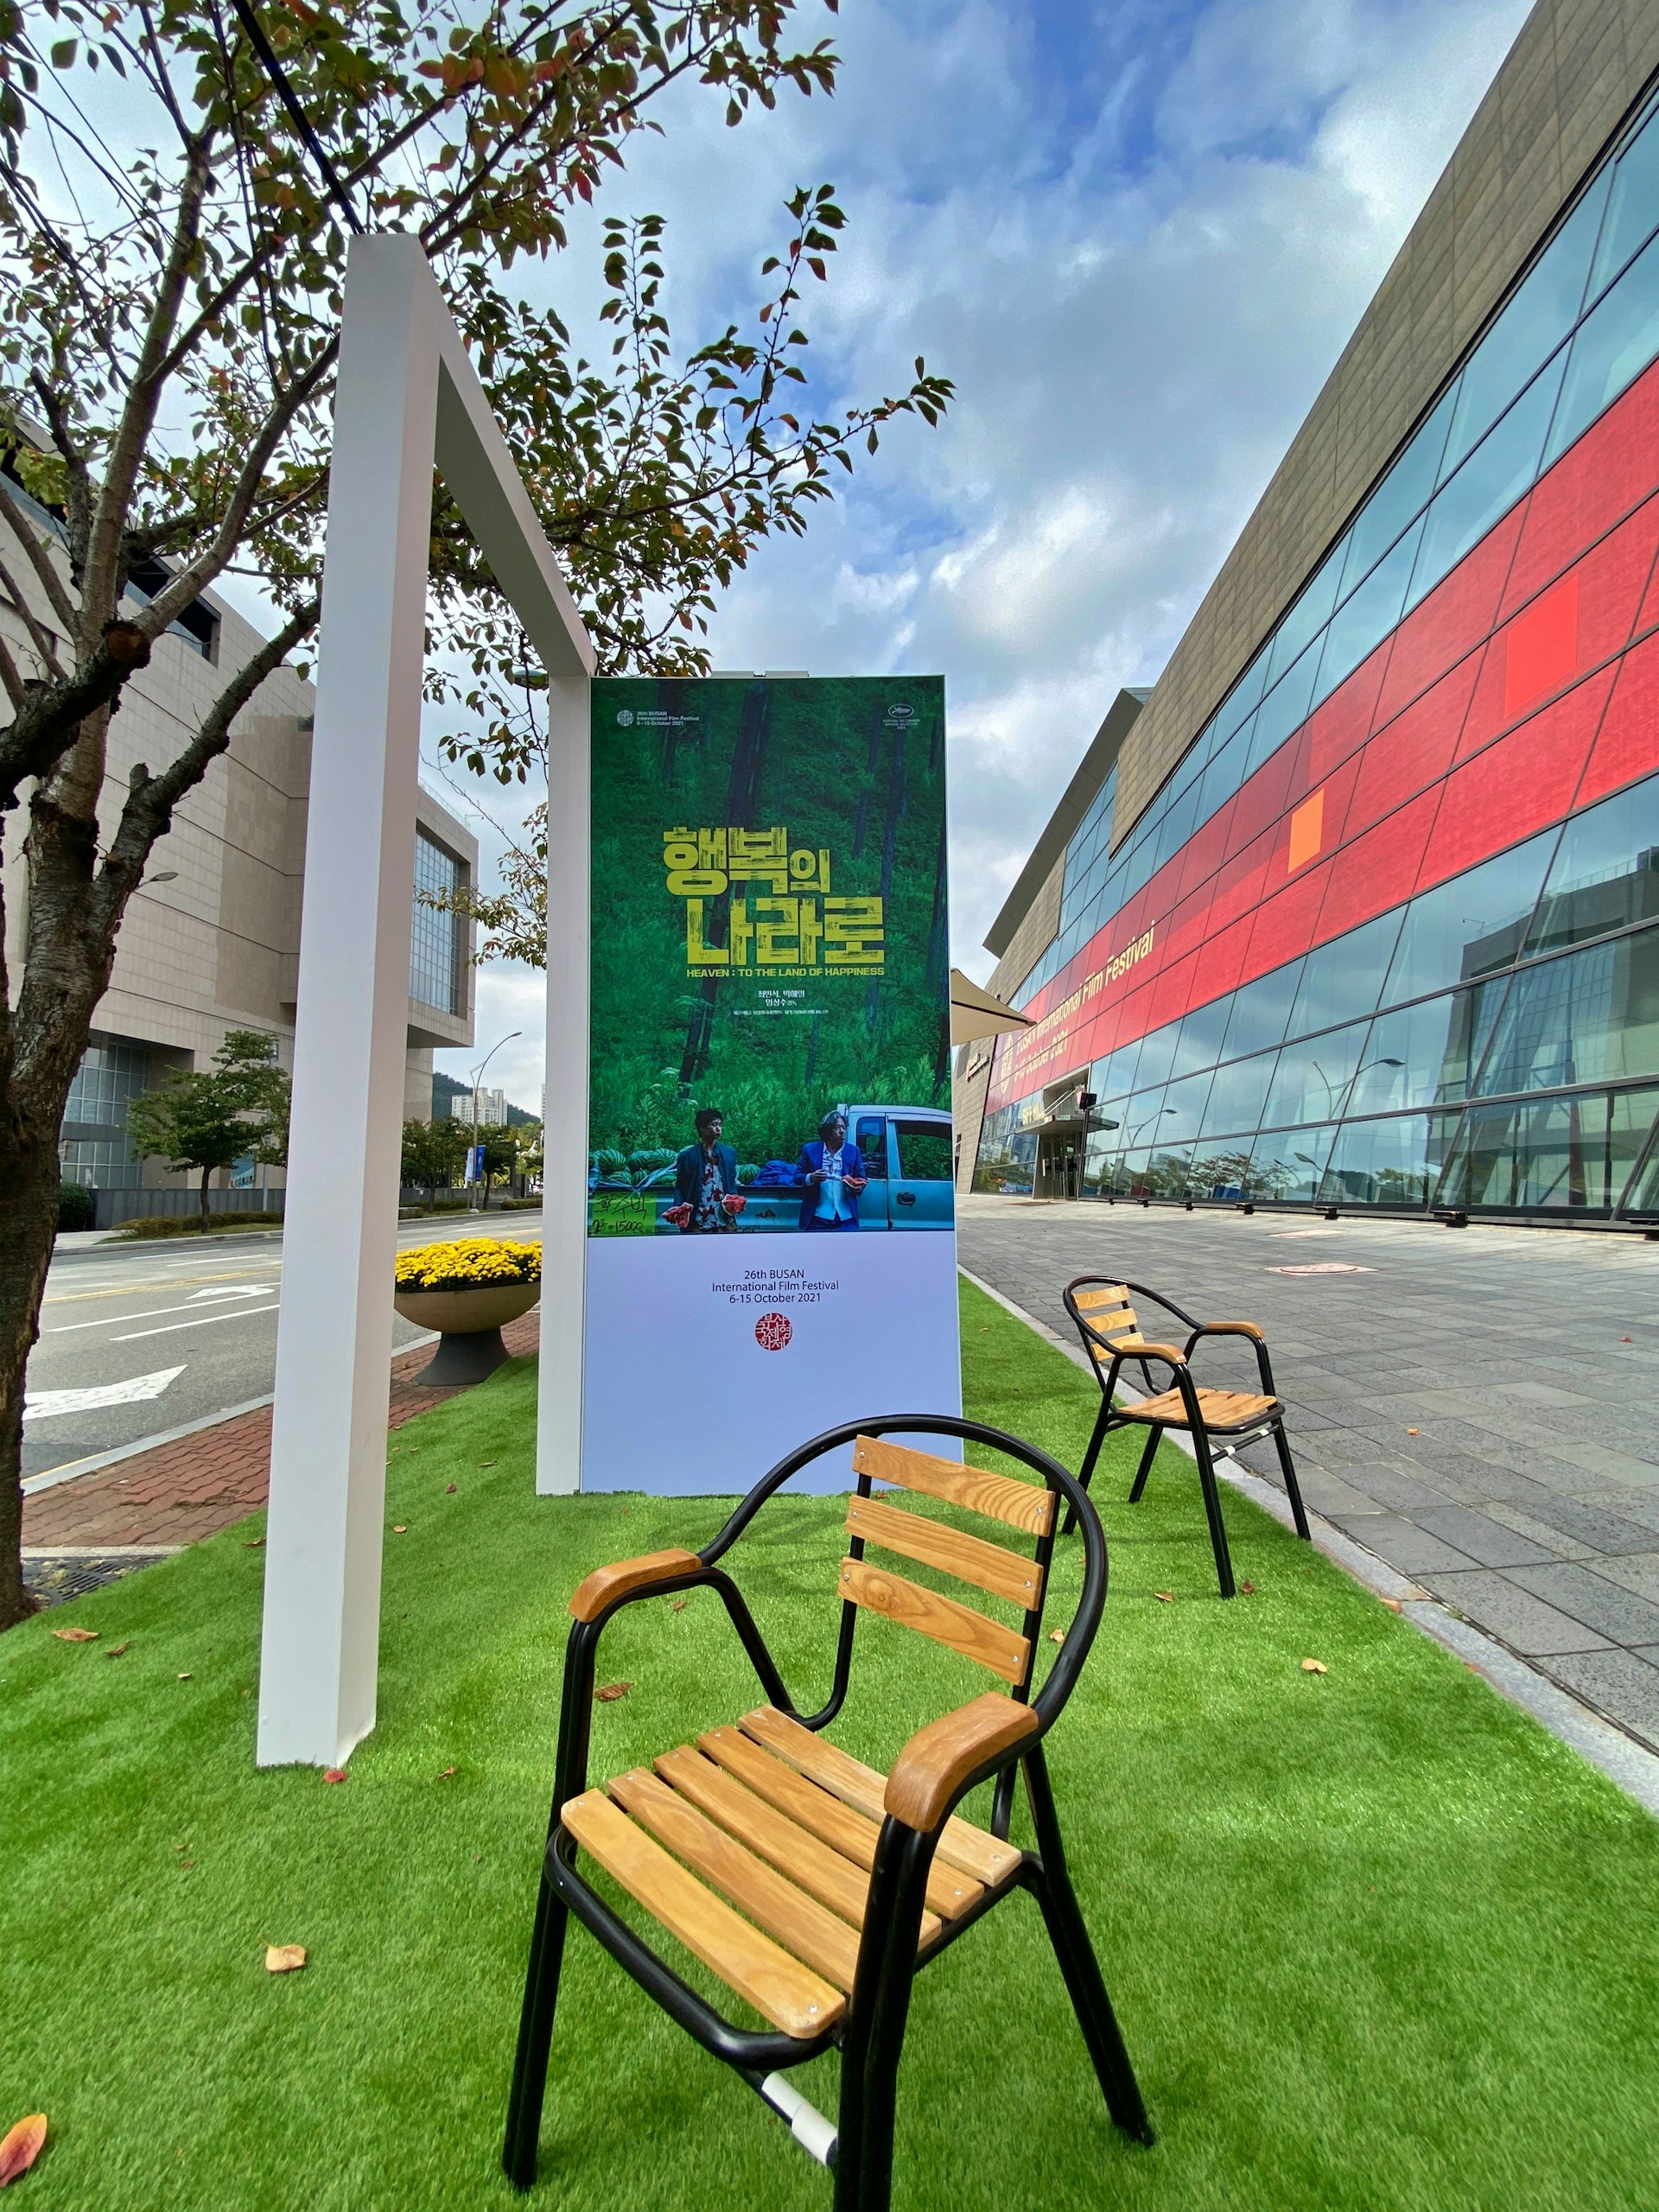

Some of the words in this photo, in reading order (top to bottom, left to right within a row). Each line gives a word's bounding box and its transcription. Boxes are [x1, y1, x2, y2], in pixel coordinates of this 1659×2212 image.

[664, 826, 830, 896] 행복의
[686, 896, 885, 965] 나라로
[1082, 970, 1103, 1004] Film
[1104, 918, 1155, 988] Festival
[687, 969, 729, 977] HEAVEN
[738, 969, 753, 977] TO
[755, 969, 776, 977] THE
[779, 968, 807, 976] LAND
[809, 968, 823, 976] OF
[825, 967, 885, 976] HAPPINESS
[744, 1270, 766, 1280] 26th
[769, 1269, 804, 1279] BUSAN
[712, 1281, 776, 1292] International
[779, 1281, 800, 1291] Film
[802, 1281, 839, 1290] Festival
[729, 1294, 752, 1304] 6-15
[753, 1294, 795, 1303] October
[798, 1293, 821, 1302] 2021
